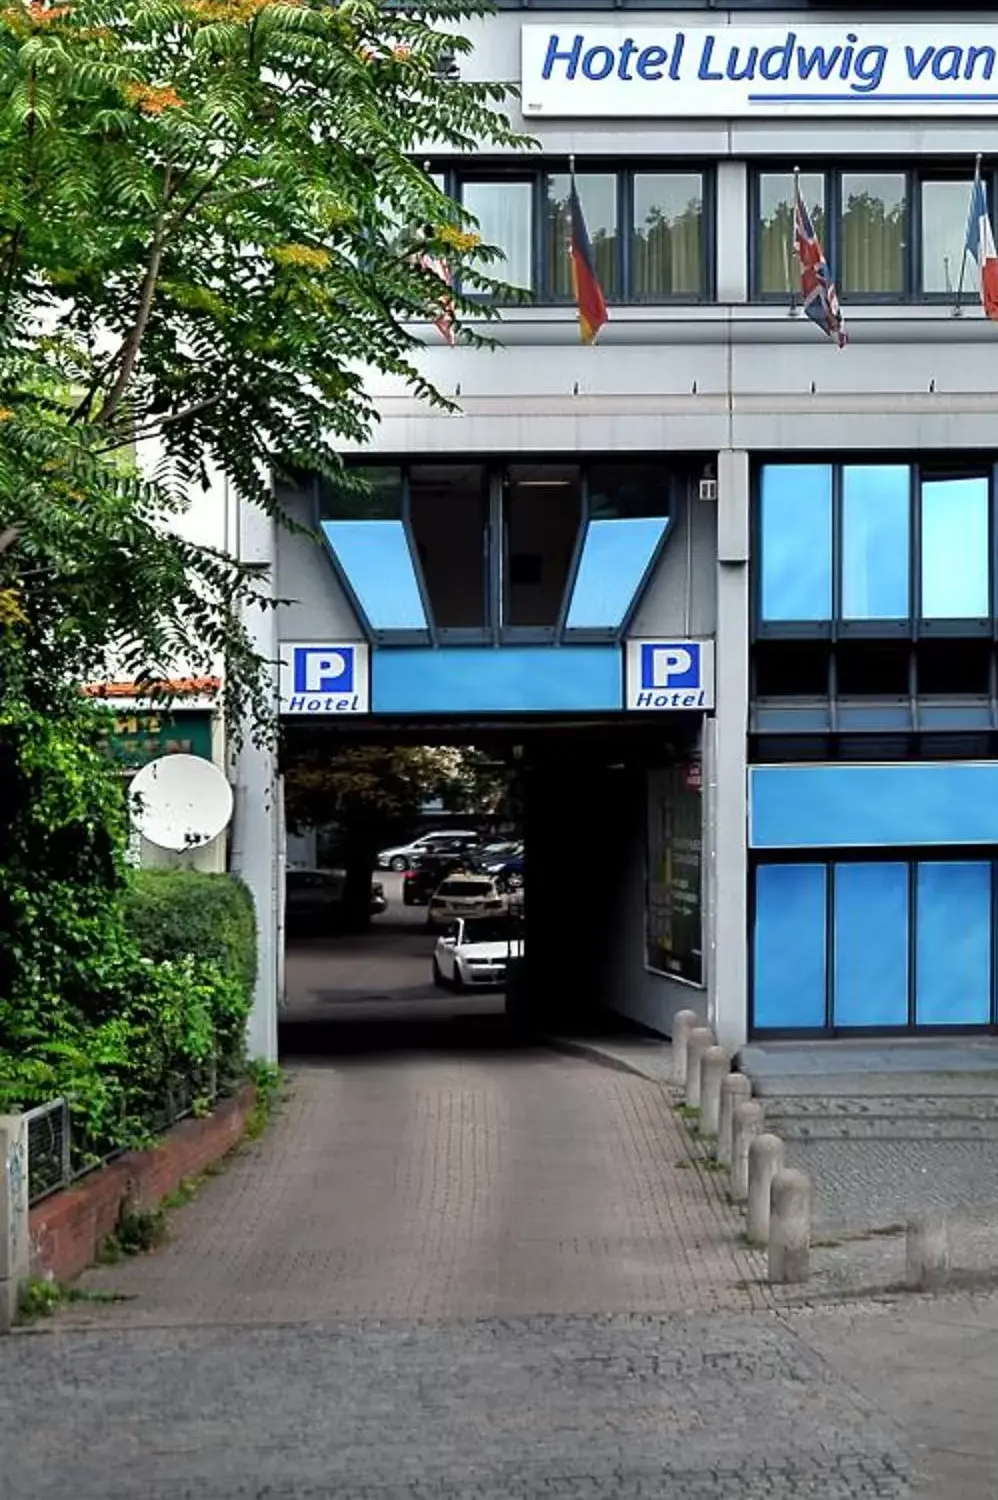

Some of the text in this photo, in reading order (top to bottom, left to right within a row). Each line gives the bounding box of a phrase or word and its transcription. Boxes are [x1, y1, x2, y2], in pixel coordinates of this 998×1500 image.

[541, 33, 684, 81] Hotel
[697, 33, 889, 92] Ludwig
[904, 45, 997, 81] van
[306, 652, 345, 691] P
[653, 649, 692, 687] P
[289, 695, 359, 711] Hotel
[636, 690, 705, 707] Hotel
